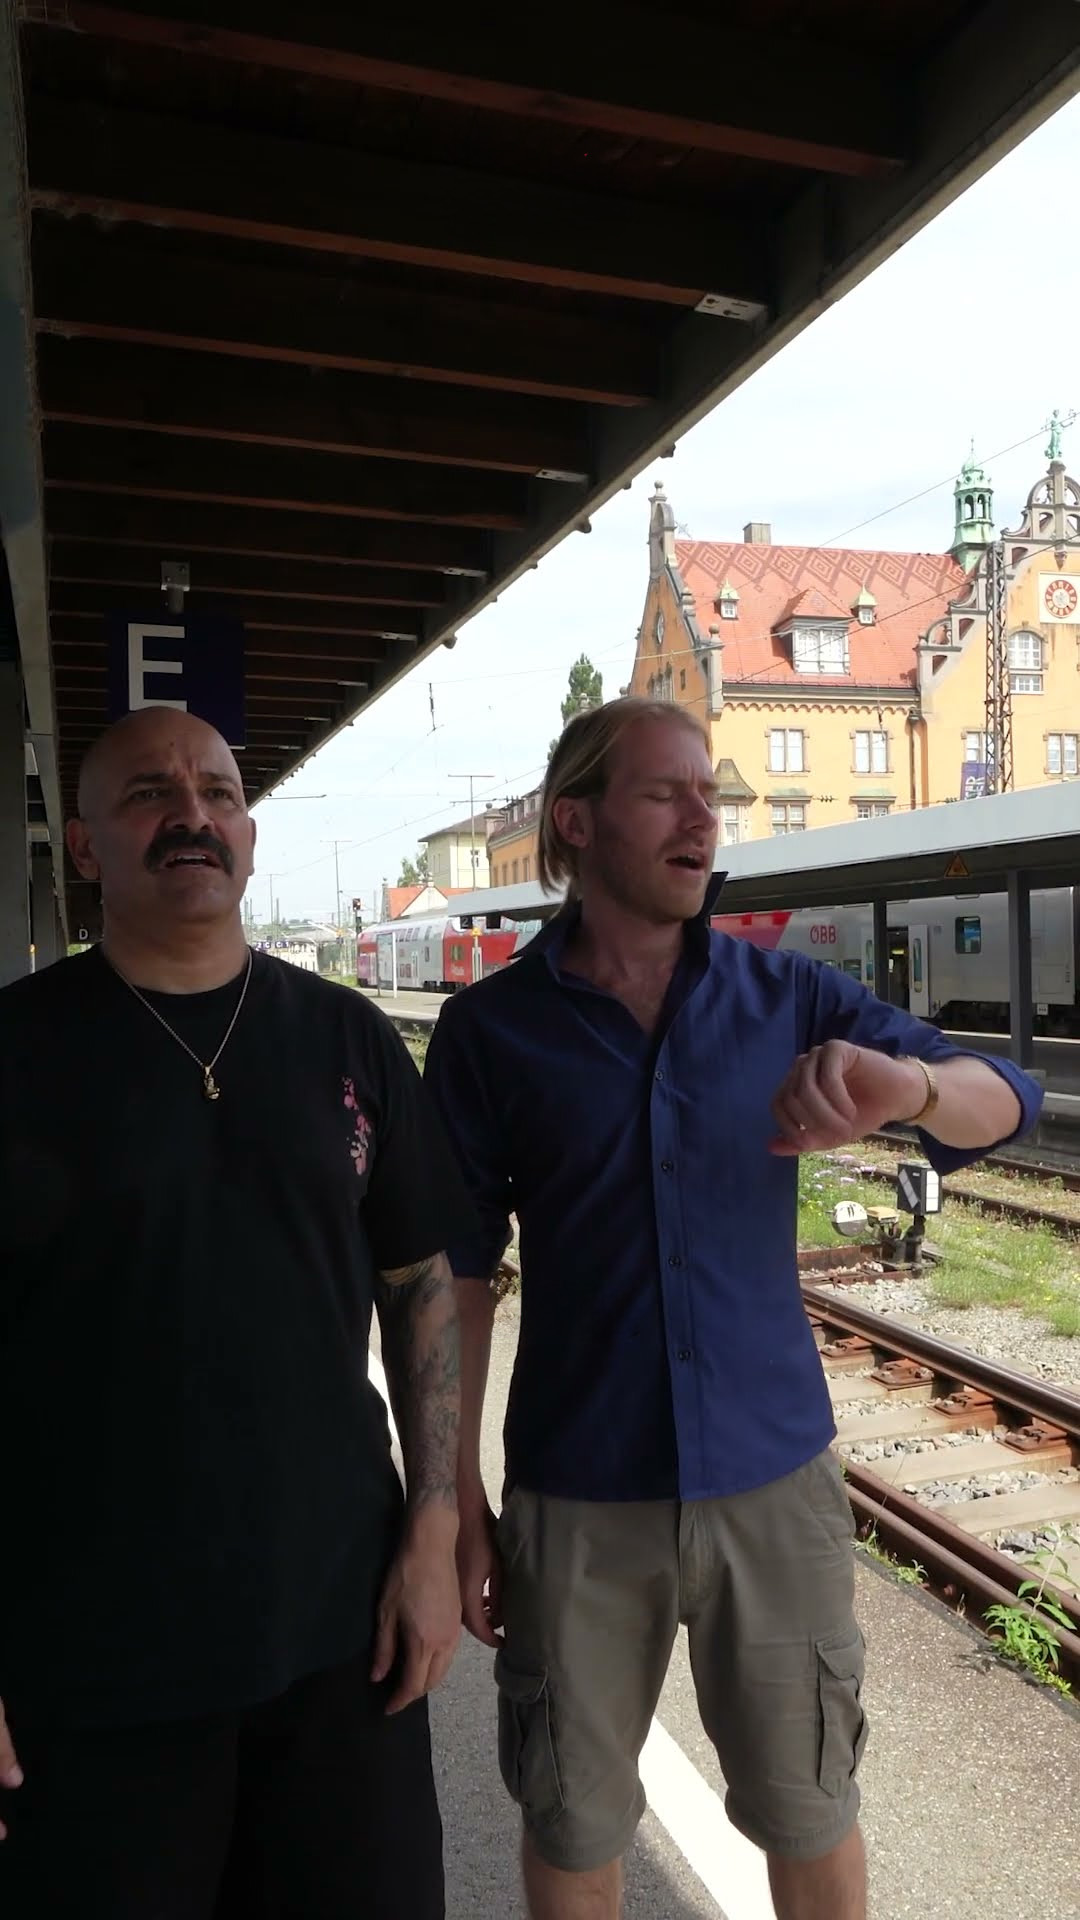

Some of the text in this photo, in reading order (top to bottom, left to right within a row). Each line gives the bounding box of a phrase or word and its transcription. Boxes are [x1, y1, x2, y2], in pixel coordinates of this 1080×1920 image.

[128, 623, 187, 712] E
[462, 917, 469, 928] 2
[79, 928, 88, 940] D
